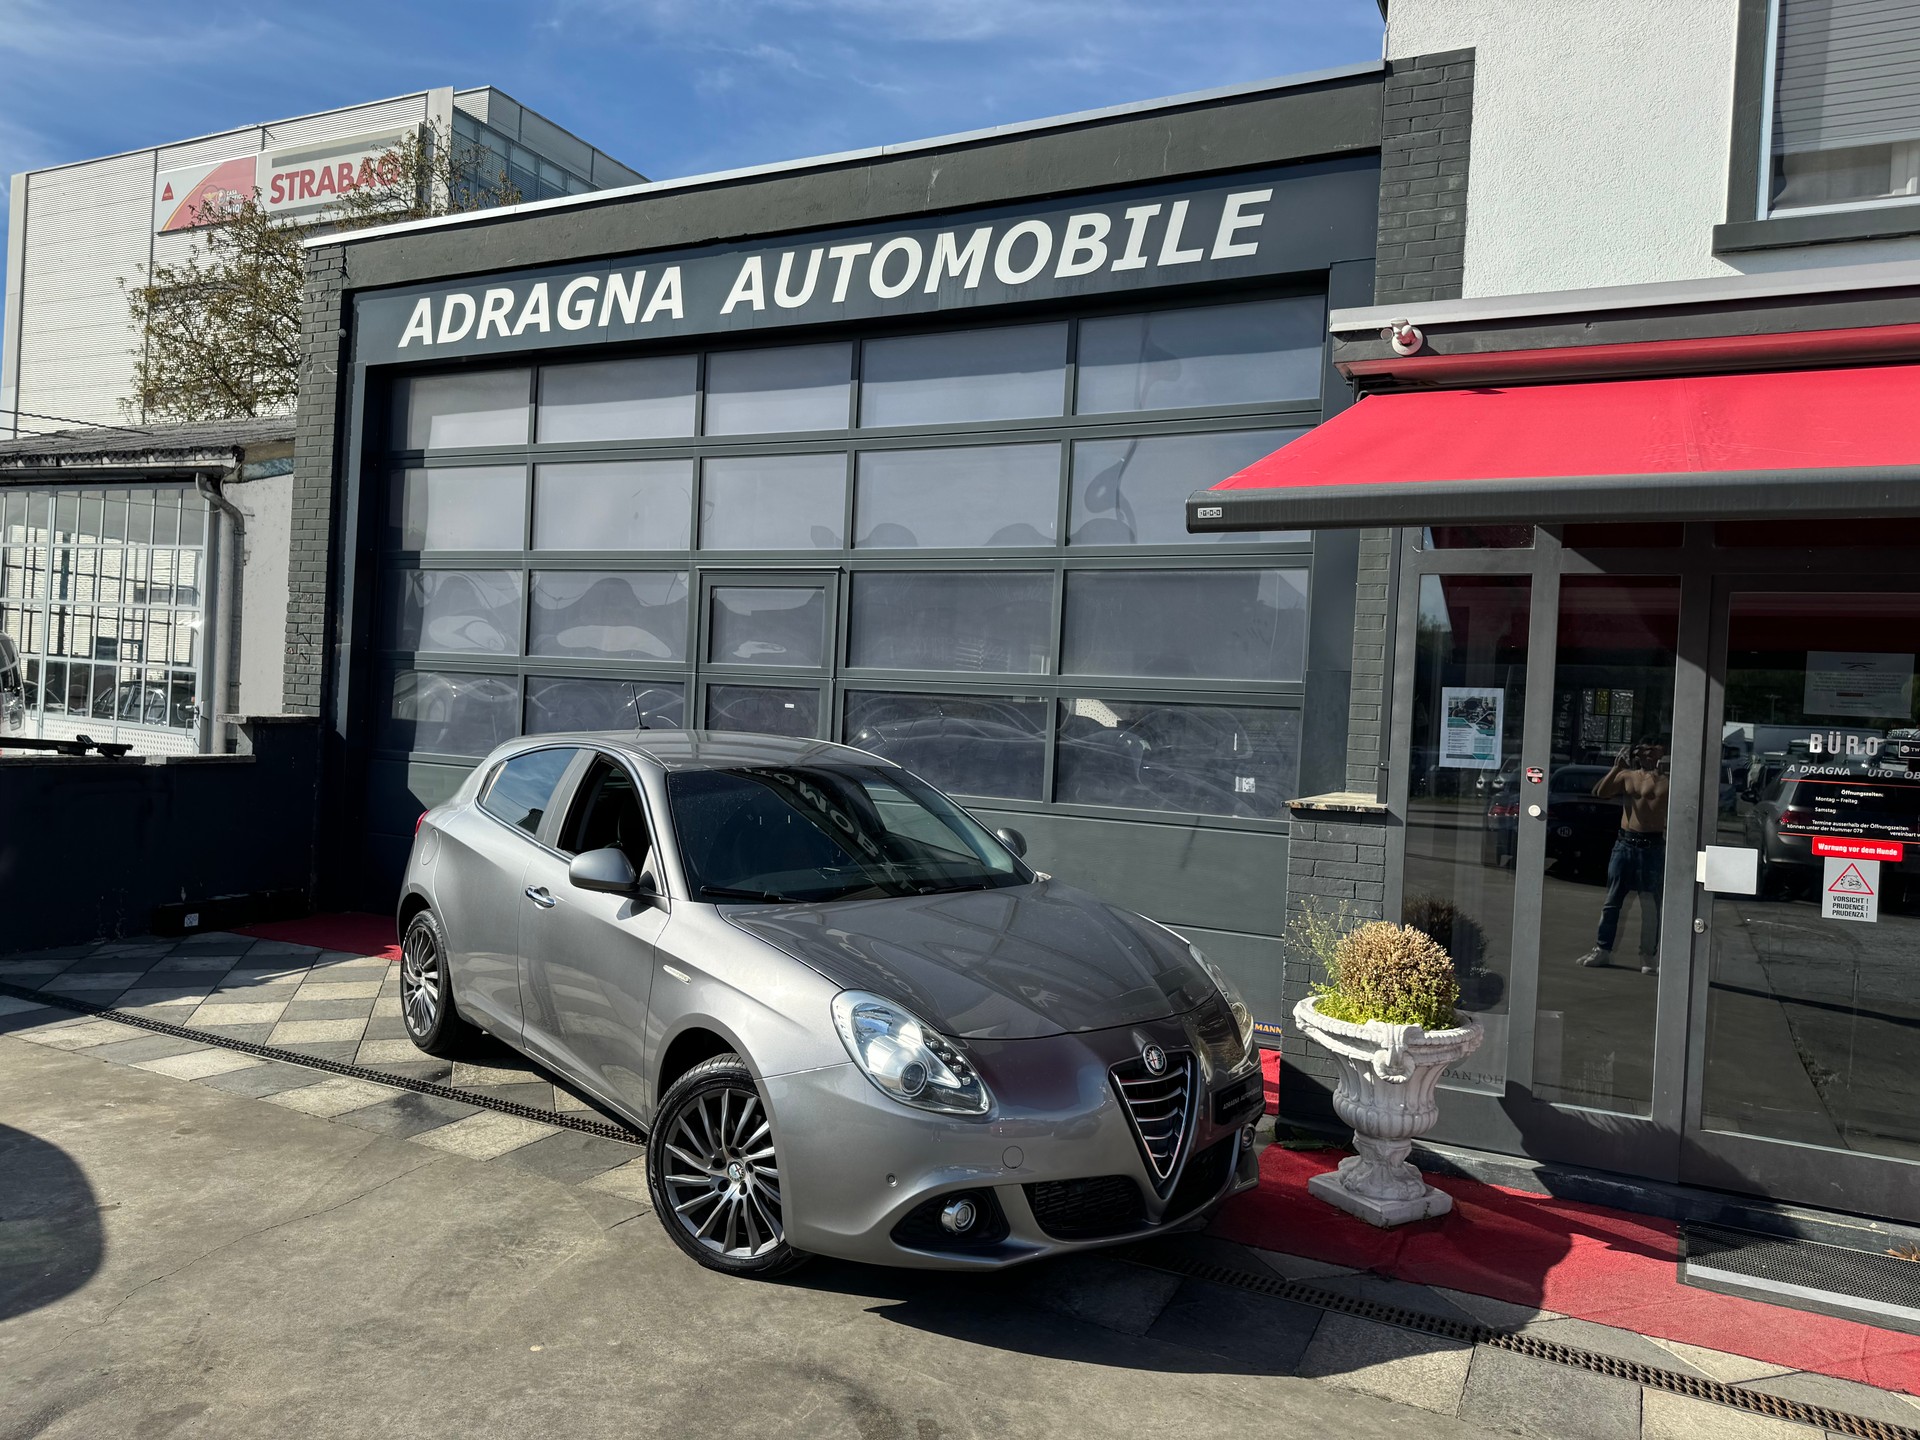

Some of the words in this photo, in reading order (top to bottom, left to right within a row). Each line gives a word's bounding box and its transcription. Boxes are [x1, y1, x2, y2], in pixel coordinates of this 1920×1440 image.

[270, 151, 401, 204] STRABAG
[397, 266, 684, 348] ADRAGNA
[720, 188, 1273, 315] AUTOMOBILE
[1809, 731, 1879, 756] BÜRO
[1815, 796, 1836, 804] Montag
[1840, 797, 1858, 805] Freitag
[1814, 806, 1837, 814] Samstag
[1889, 830, 1916, 838] vereinbart
[1818, 843, 1847, 853] Warnung
[1848, 846, 1860, 854] vor
[1876, 847, 1898, 856] Hunde
[1832, 895, 1865, 904] VORSICHT
[1832, 902, 1865, 911] PRUDENCE
[1832, 910, 1865, 918] PRUDENZA
[1254, 1023, 1282, 1034] MANN
